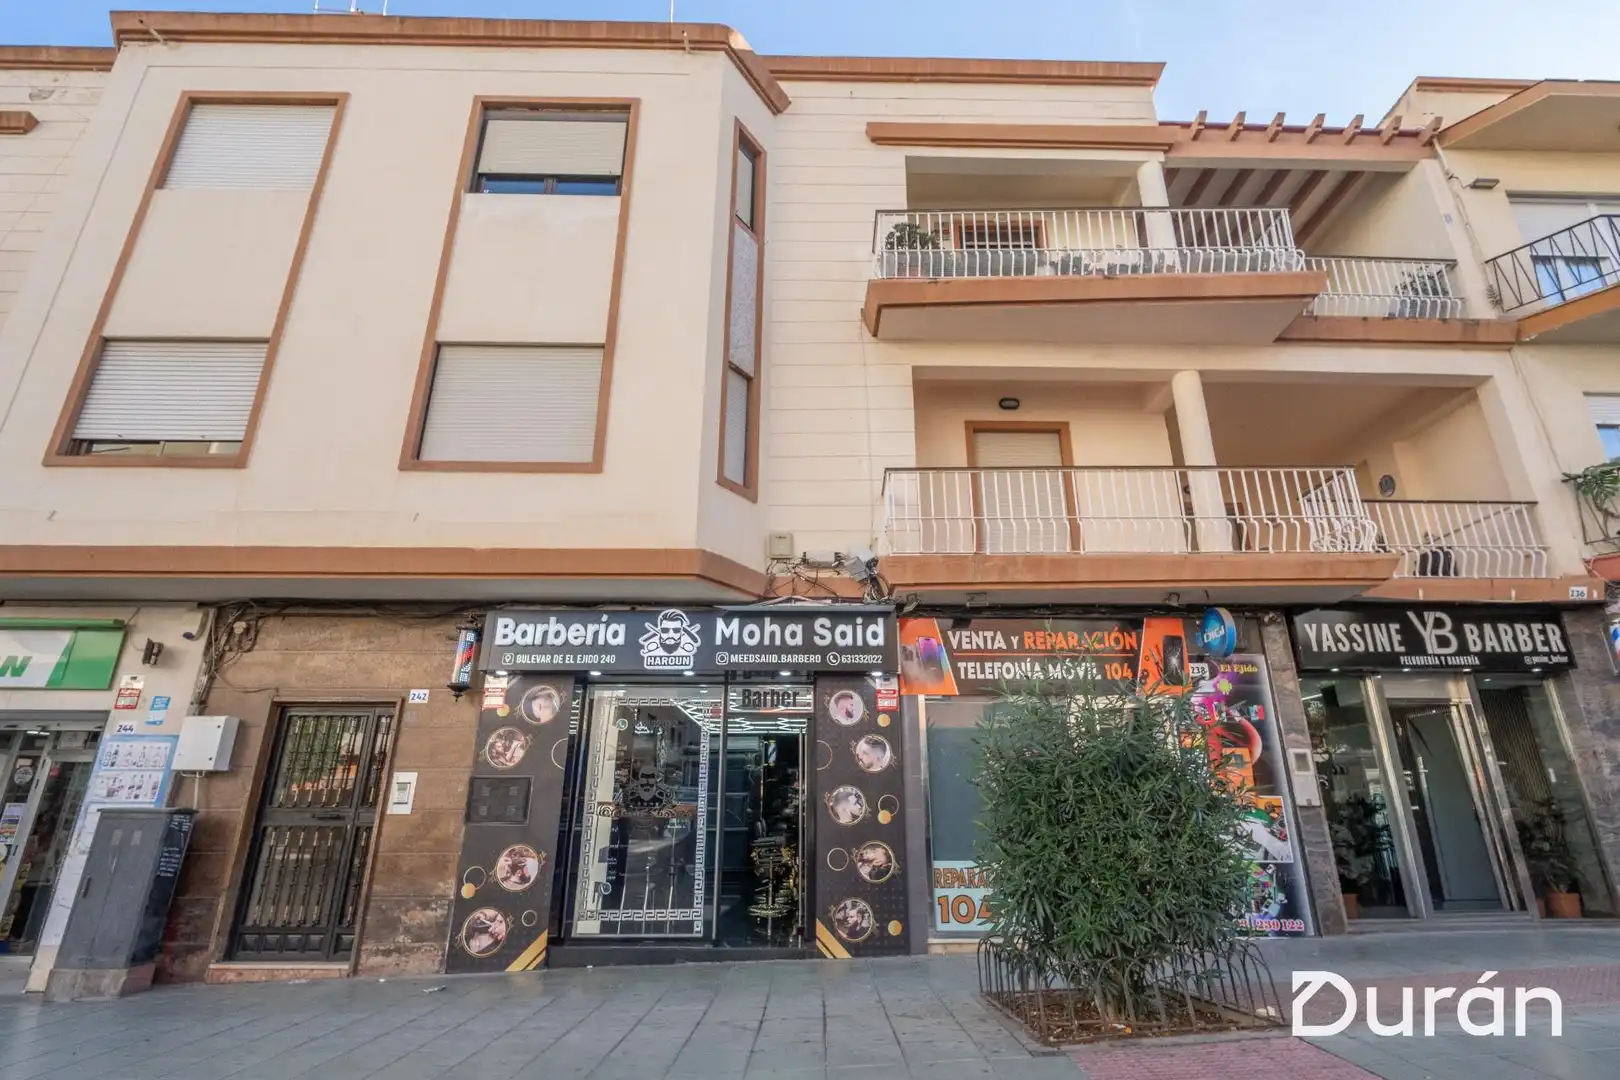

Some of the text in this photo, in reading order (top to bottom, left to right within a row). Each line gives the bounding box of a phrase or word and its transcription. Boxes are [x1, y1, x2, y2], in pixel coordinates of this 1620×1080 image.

[1571, 589, 1585, 598] 236
[495, 614, 626, 646] Barbería
[715, 617, 884, 646] Moha Said
[1203, 625, 1225, 643] DIGI
[947, 630, 1007, 650] VENTA
[1304, 623, 1406, 652] YASSINE
[1463, 623, 1567, 653] BARBER
[516, 654, 616, 664] BULEVAR DE EL EJIDO 240
[647, 656, 691, 666] HAROUN
[841, 654, 883, 664] 631332022
[957, 657, 1044, 680] TELEFONÍA
[1104, 662, 1133, 680] 104
[1190, 666, 1207, 675] 238
[1234, 664, 1258, 674] Ejido
[411, 693, 427, 701] 242
[741, 689, 799, 707] Barber
[117, 723, 134, 732] 244
